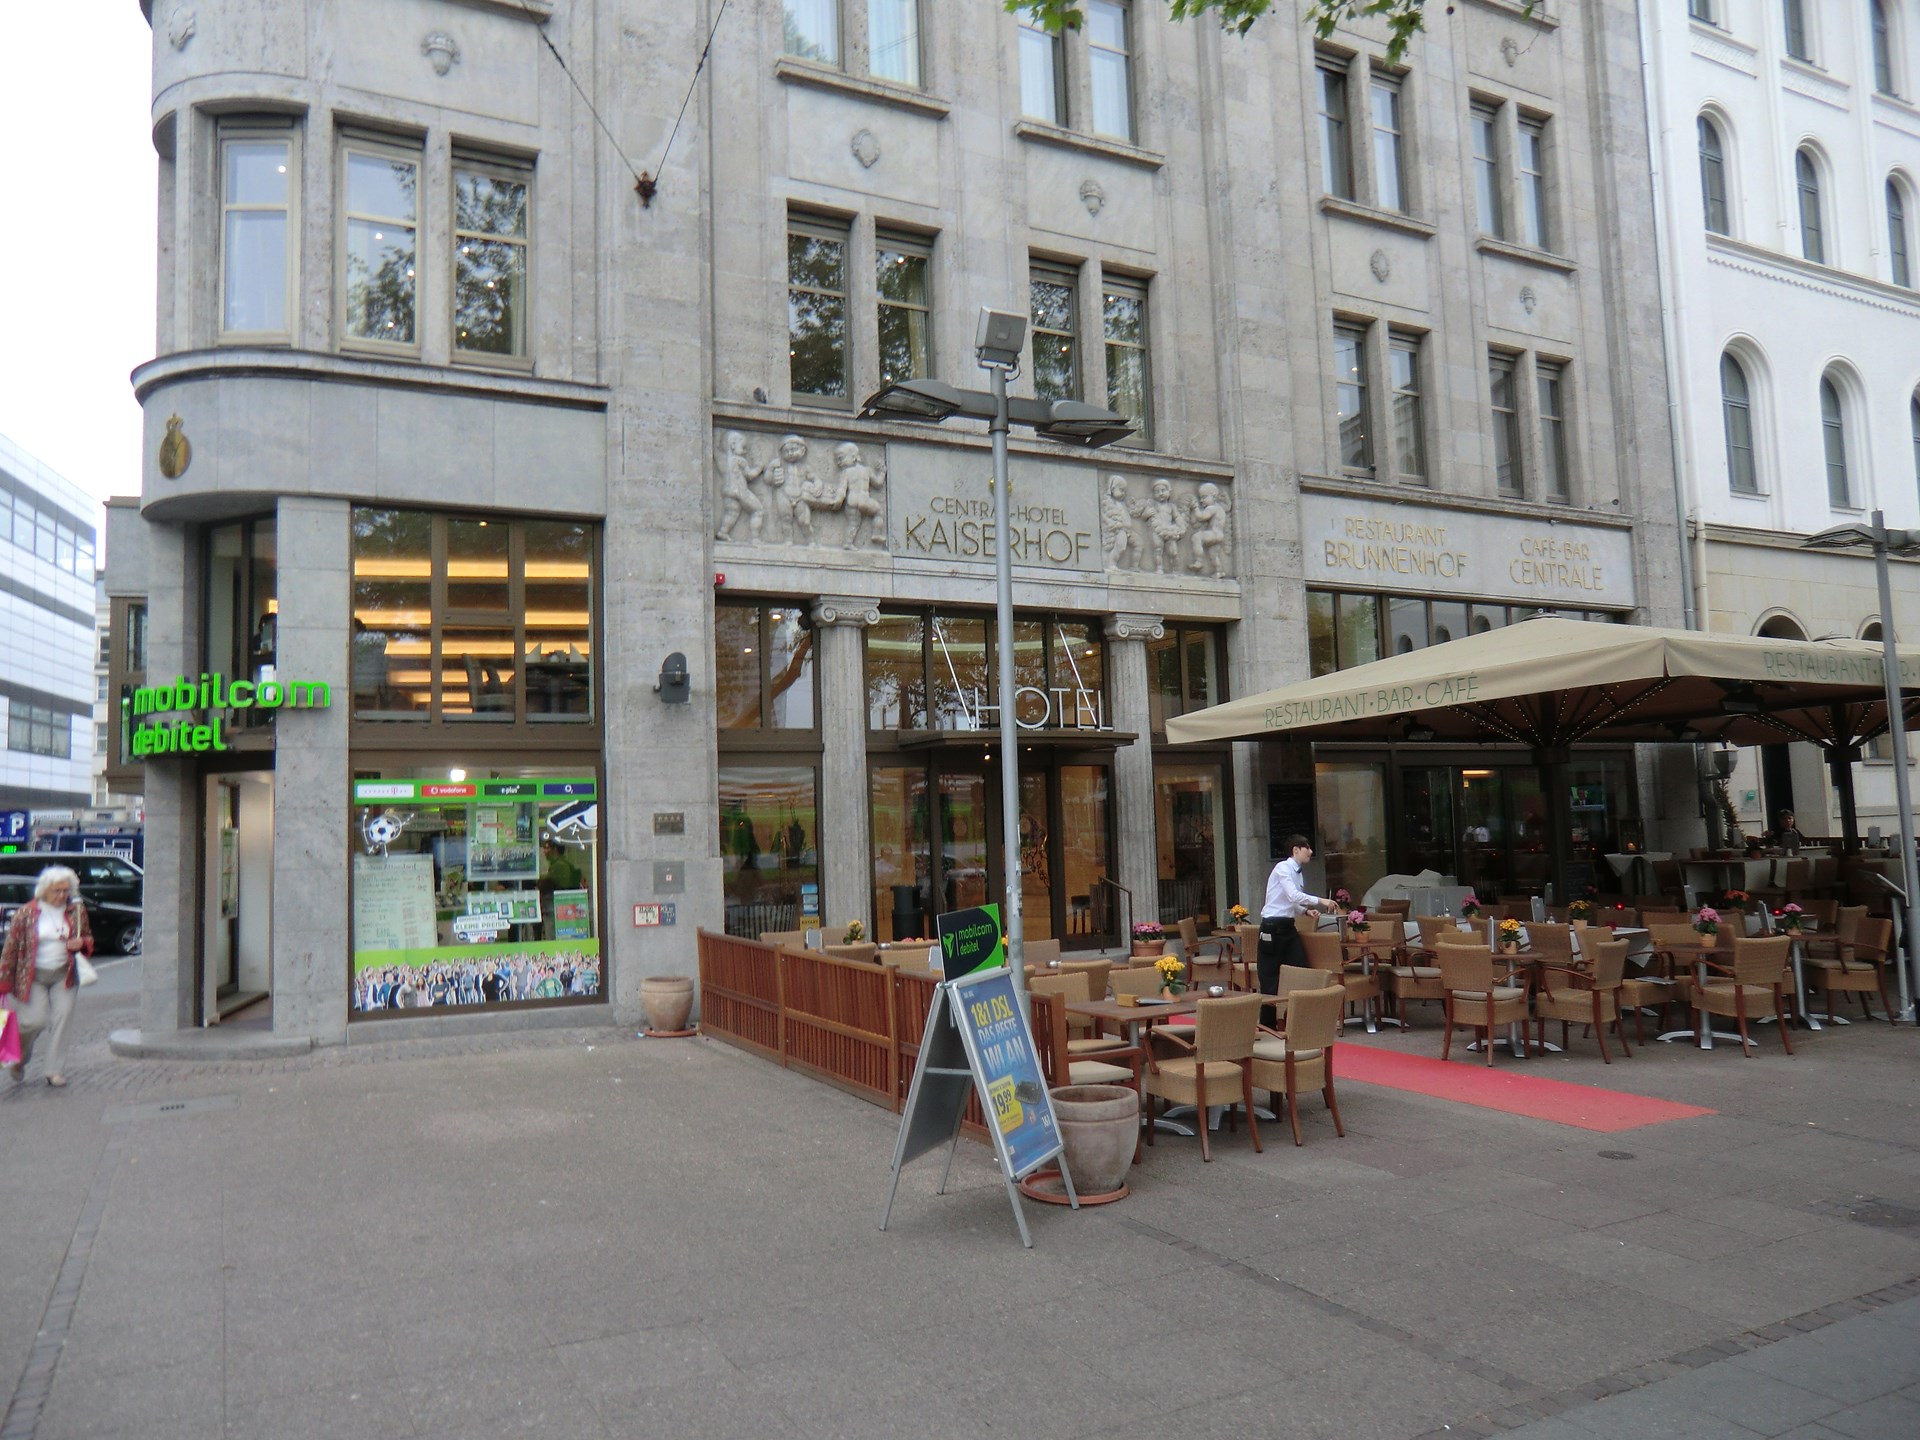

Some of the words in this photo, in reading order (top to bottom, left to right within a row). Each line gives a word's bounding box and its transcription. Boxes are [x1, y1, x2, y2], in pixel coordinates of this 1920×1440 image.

[930, 496, 1069, 527] CENTR-HOTEL
[905, 516, 1092, 563] KAISERHOF
[1345, 516, 1447, 547] RESTAURANT
[1324, 540, 1469, 578] BRUNNENHOF
[1509, 559, 1604, 591] CENTRALE
[1764, 651, 1872, 682] RESTAURANT
[133, 672, 331, 716] mobilcom
[975, 686, 1114, 730] HOTEL
[1264, 692, 1369, 729] RESTAURANT
[1377, 686, 1414, 713] BAR
[132, 717, 228, 756] debitel
[440, 786, 467, 795] vodafone
[958, 923, 992, 941] mobilcom
[960, 939, 980, 955] debitel
[971, 1000, 993, 1028] 1&1
[991, 994, 1014, 1021] DSL
[978, 1025, 997, 1047] DAS
